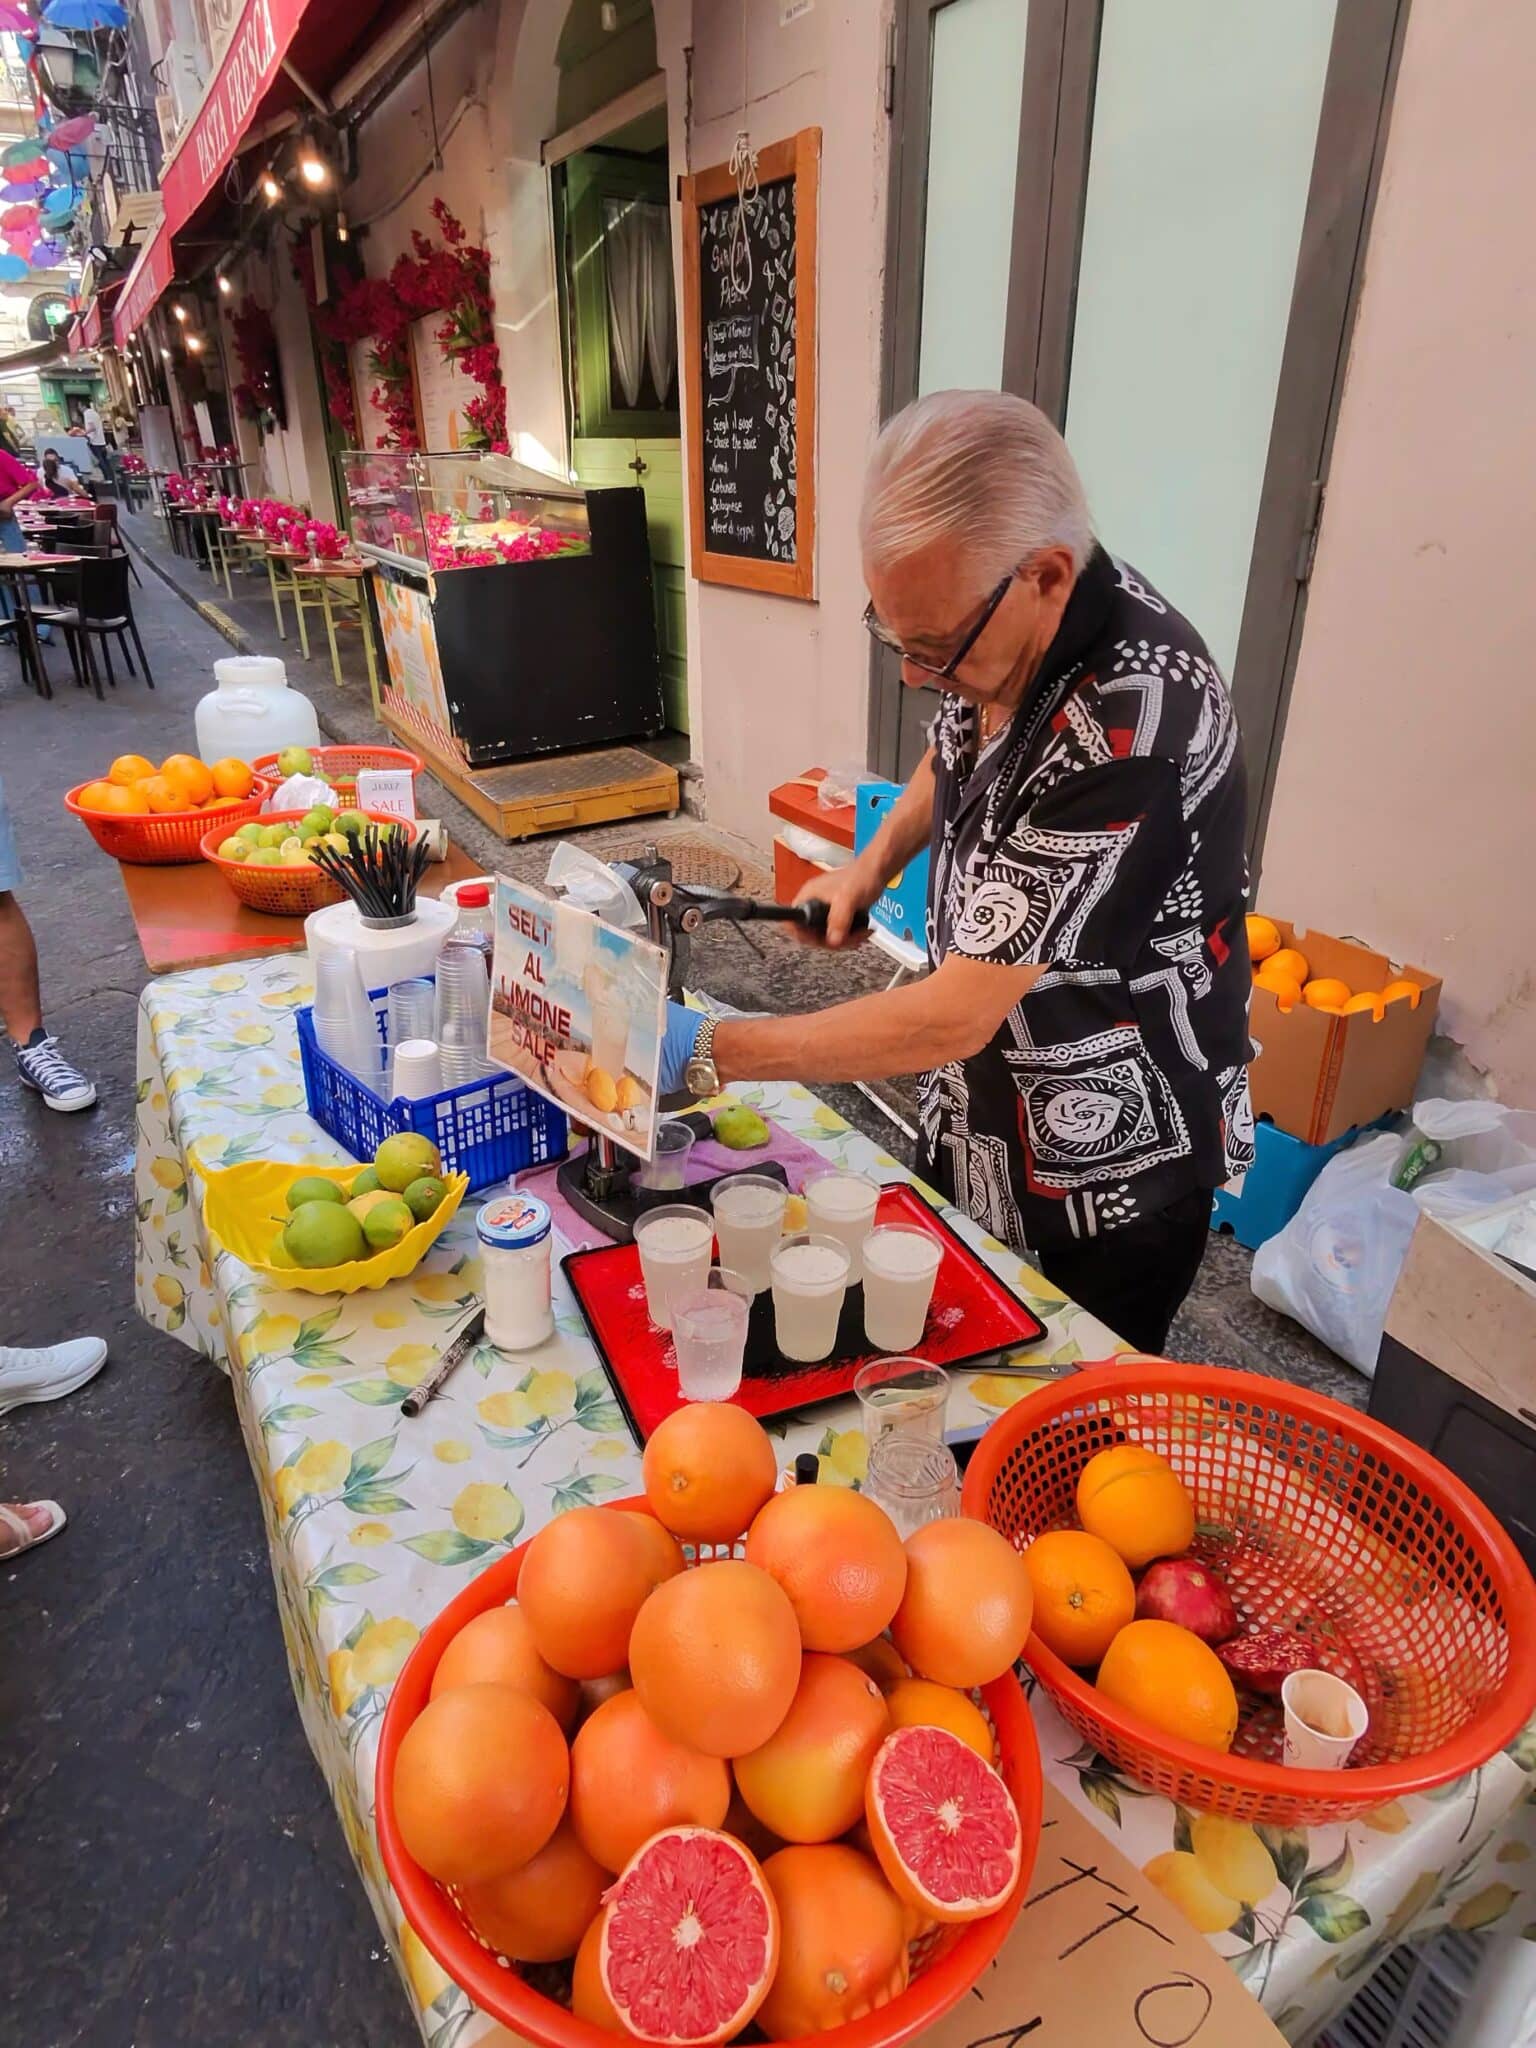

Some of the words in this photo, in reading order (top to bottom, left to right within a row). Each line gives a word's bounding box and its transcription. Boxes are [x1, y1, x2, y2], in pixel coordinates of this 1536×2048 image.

[196, 92, 230, 185] PASTA
[226, 0, 277, 135] FRESCA
[371, 799, 406, 813] SALE
[878, 895, 904, 920] AVO
[523, 951, 546, 986] AL
[501, 975, 571, 1038] LIMONE
[511, 1018, 556, 1069] SALE
